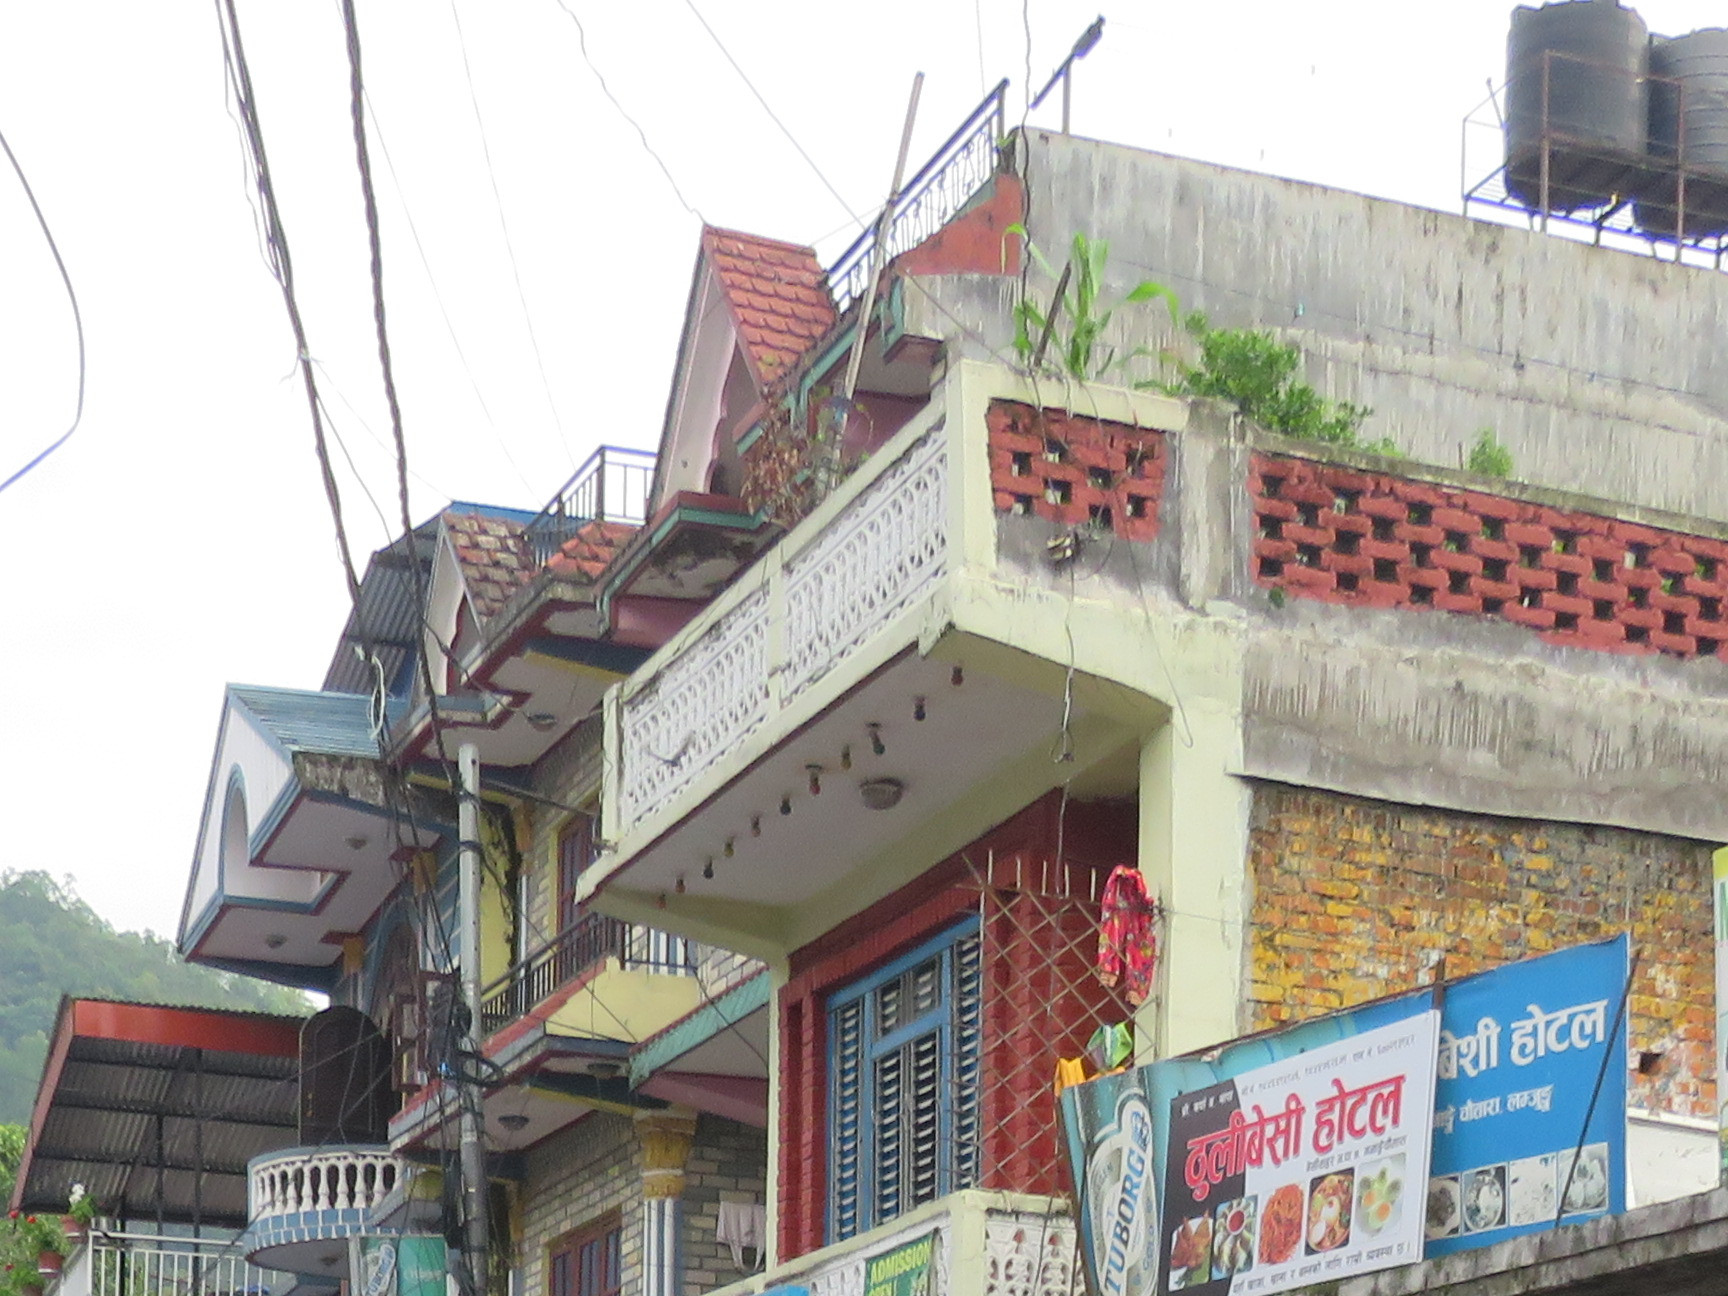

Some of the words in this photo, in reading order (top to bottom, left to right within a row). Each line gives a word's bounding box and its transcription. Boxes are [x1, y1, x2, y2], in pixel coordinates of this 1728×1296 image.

[1511, 999, 1609, 1066] होटल
[1185, 1092, 1306, 1201] ठुलीबेसी
[1312, 1076, 1406, 1155] होटल
[870, 1241, 931, 1286] ADMISSION
